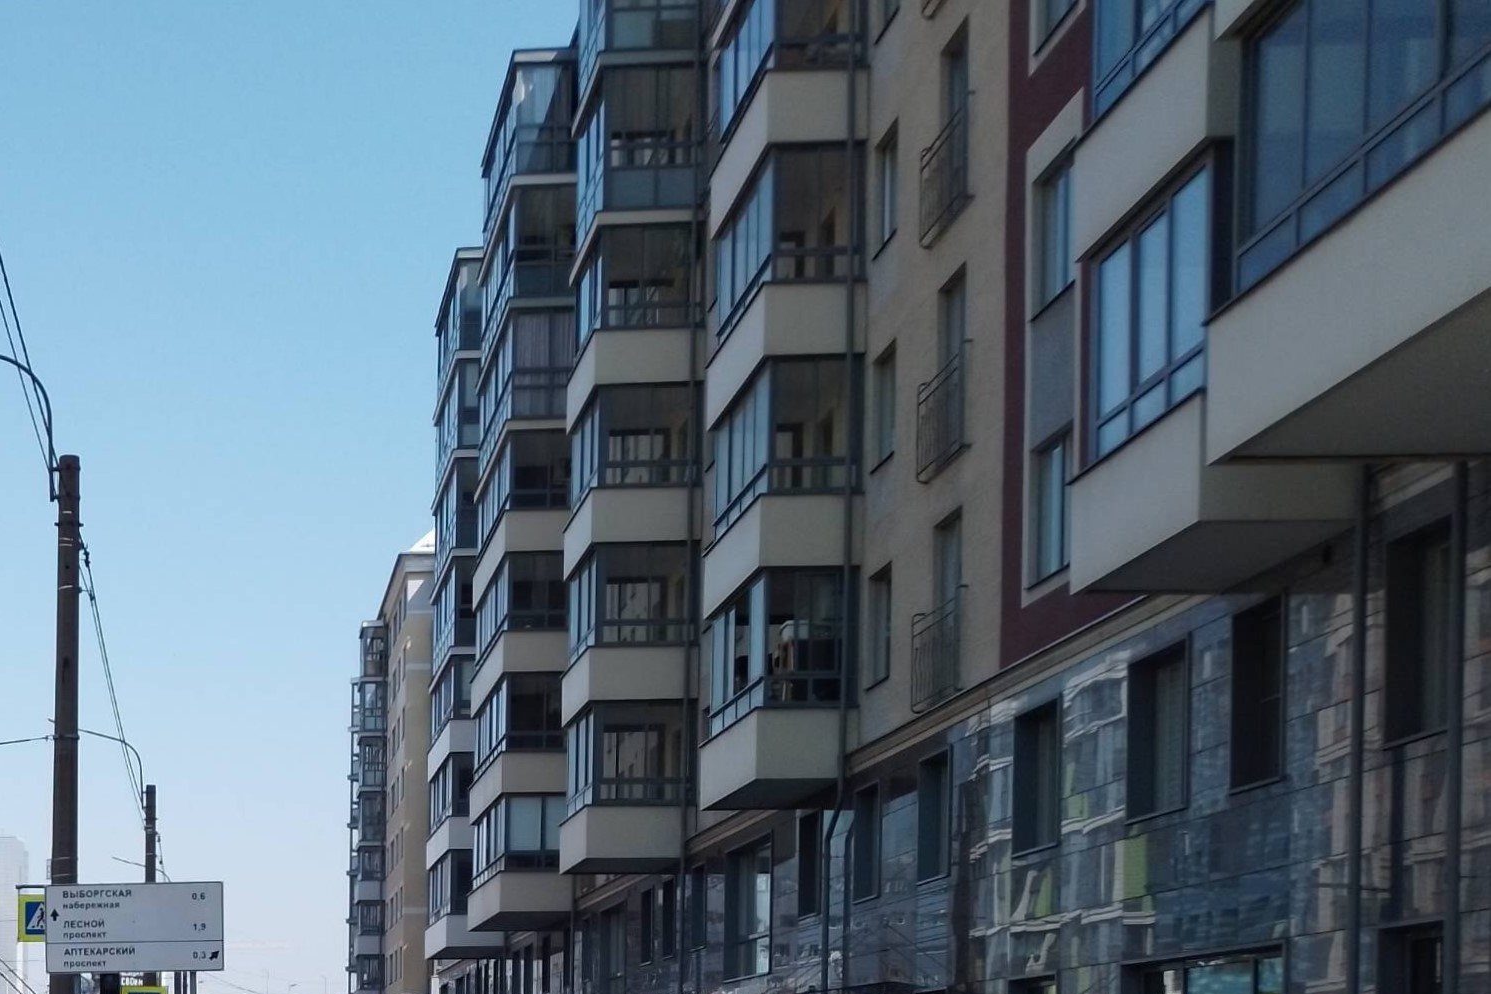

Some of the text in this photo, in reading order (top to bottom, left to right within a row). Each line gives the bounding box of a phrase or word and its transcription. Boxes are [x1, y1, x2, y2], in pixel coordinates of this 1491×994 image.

[62, 890, 206, 901] ВЫБОРГСКАЯ 0,6
[62, 901, 120, 909] набережная
[63, 920, 206, 931] ЛЕСНОЙ 1,9
[63, 931, 107, 940] проспект
[64, 947, 207, 960] АПТЕКАРСКИЙ 0,3
[64, 960, 107, 968] проспект
